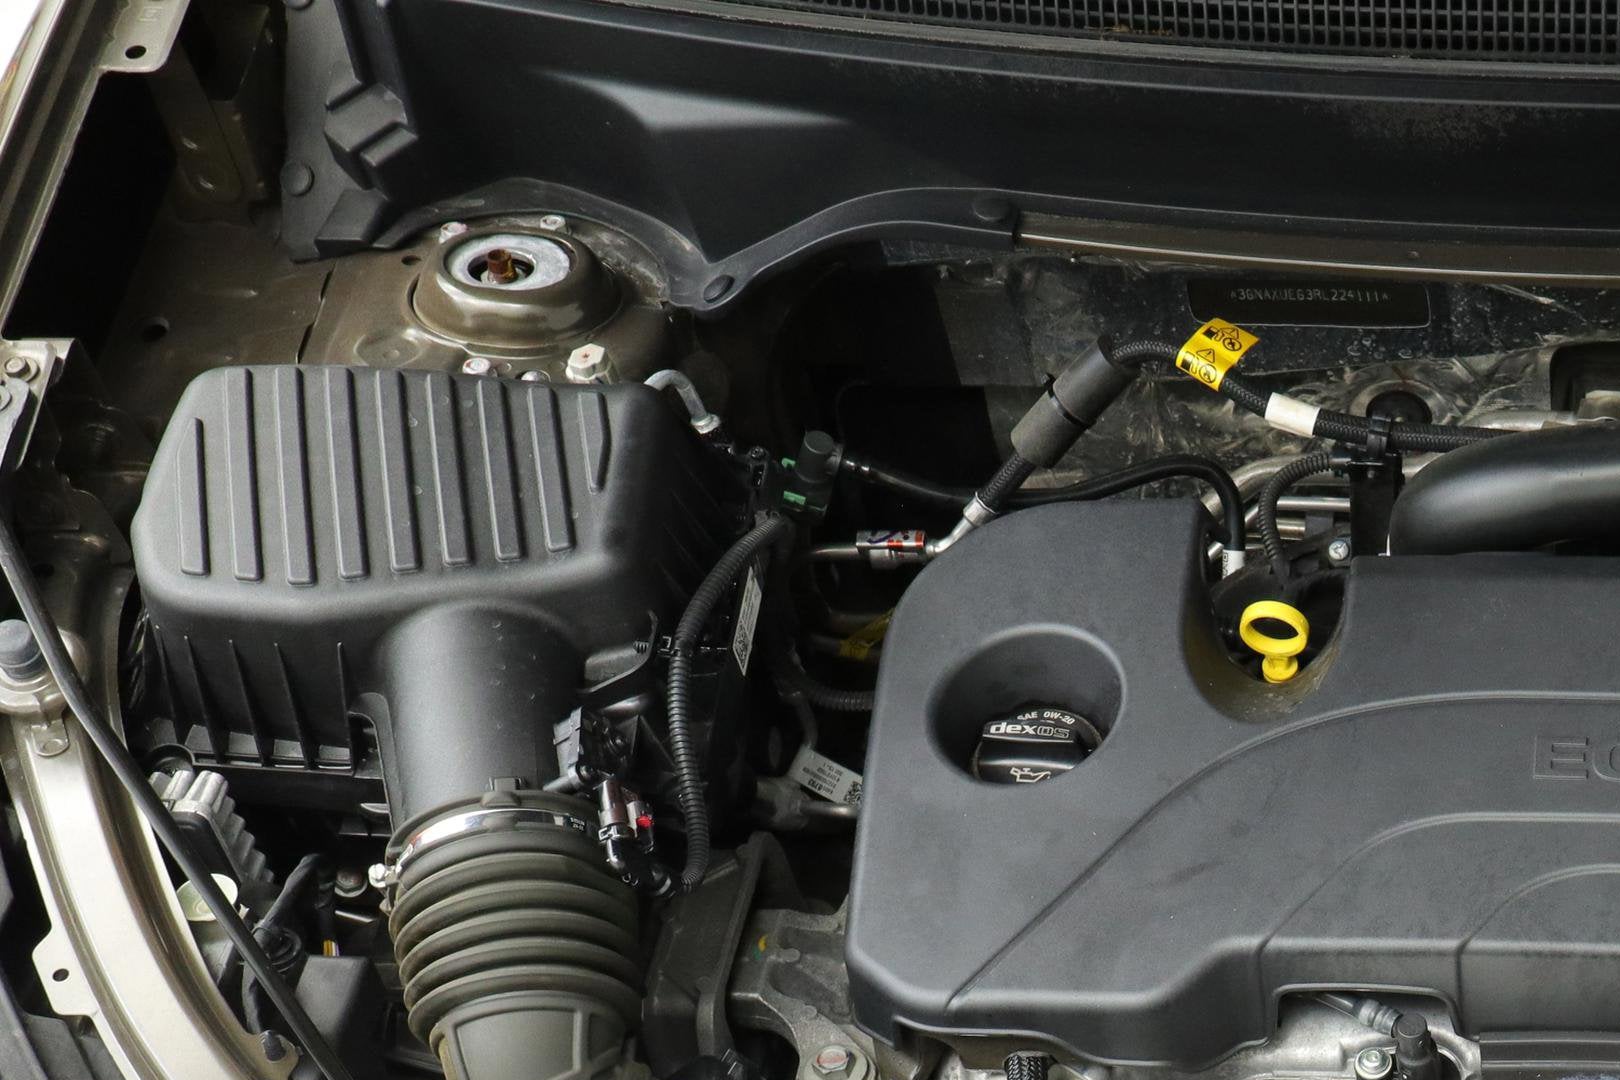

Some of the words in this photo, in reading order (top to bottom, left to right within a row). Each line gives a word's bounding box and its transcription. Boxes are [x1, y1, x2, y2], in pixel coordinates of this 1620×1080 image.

[1016, 711, 1038, 720] SAE
[1043, 711, 1075, 724] 0W-20
[990, 722, 1070, 738] dexos
